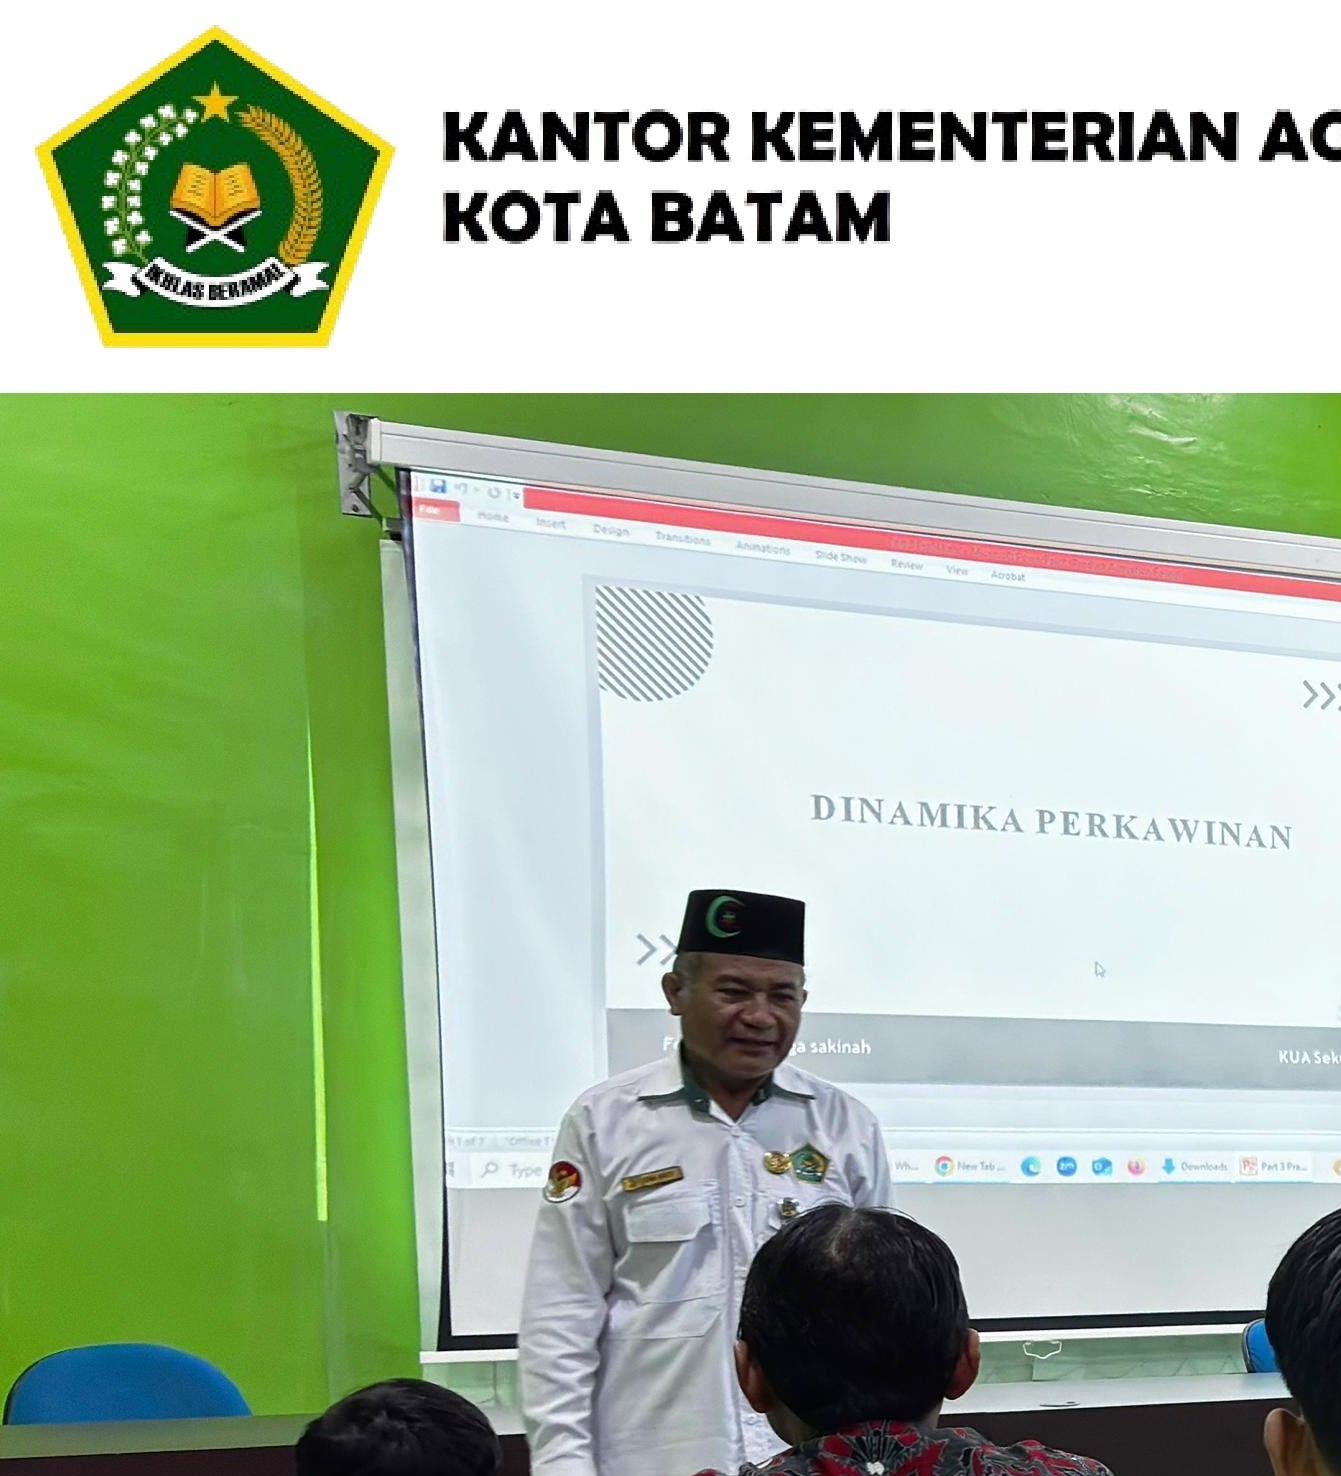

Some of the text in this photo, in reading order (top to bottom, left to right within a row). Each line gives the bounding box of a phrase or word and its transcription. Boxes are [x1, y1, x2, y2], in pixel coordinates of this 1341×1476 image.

[536, 517, 567, 532] Insert
[593, 523, 630, 539] Design
[655, 531, 712, 548] Transitions
[736, 541, 792, 557] Animations
[815, 549, 868, 566] Slide Show
[891, 558, 924, 572] Review
[946, 565, 969, 577] View
[991, 569, 1026, 582] Acrobat
[810, 794, 1293, 850] DINAMIKA PERKAWINAN
[811, 1038, 872, 1055] sakinah
[1279, 1050, 1311, 1066] KUA
[508, 1163, 543, 1178] Type
[957, 1161, 995, 1171] New Tab
[1181, 1162, 1228, 1172] Downloads
